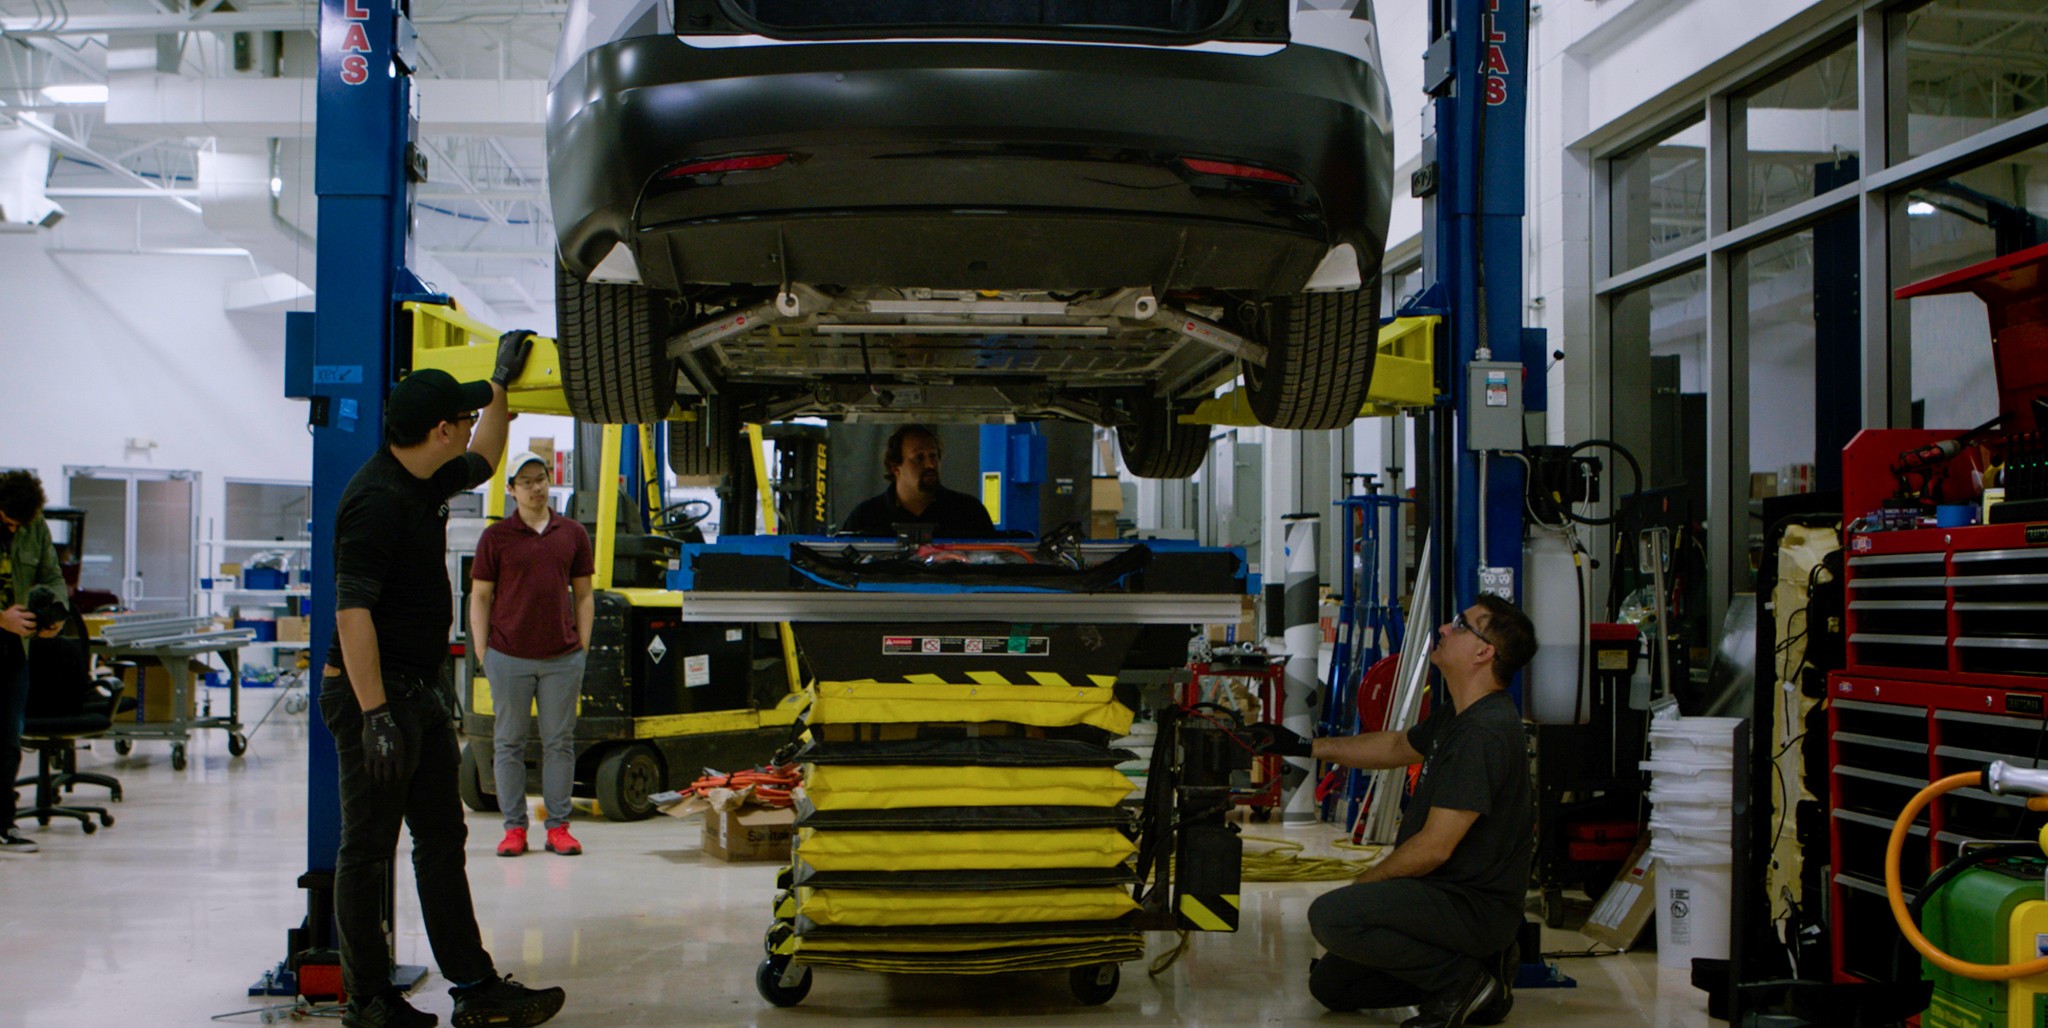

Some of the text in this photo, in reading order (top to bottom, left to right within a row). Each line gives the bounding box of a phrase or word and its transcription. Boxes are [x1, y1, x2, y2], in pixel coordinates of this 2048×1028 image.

[1478, 0, 1510, 106] LAS
[318, 367, 339, 381] KEY
[815, 442, 827, 523] HYSTER
